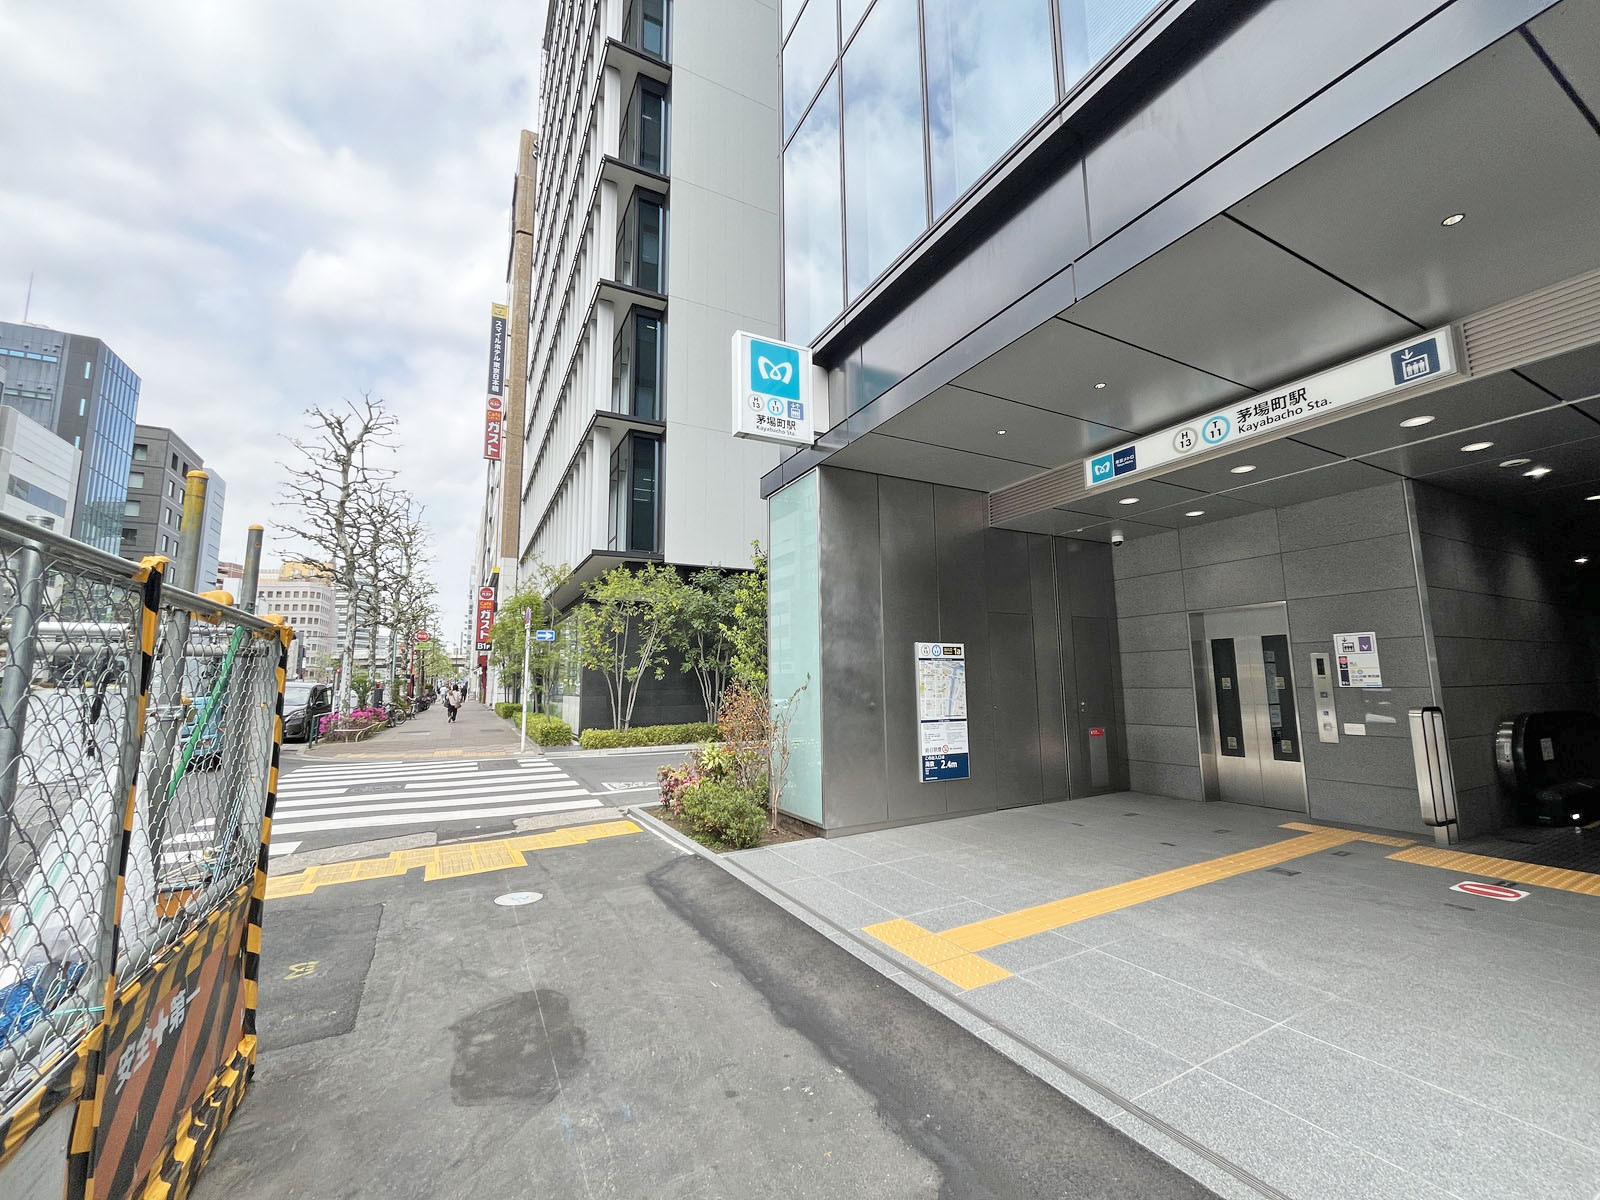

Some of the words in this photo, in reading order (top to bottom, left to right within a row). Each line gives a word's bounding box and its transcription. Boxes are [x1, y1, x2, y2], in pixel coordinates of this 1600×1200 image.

[1236, 387, 1308, 424] 茅場町駅
[1238, 406, 1303, 434] Kayabacho
[1307, 397, 1333, 411] Sta.
[756, 414, 797, 431] 茅場町駅
[1212, 421, 1219, 429] T
[756, 425, 786, 435] Kayabacho
[1181, 431, 1189, 439] H
[1210, 428, 1222, 439] 11
[488, 421, 500, 456] ガスト
[1180, 438, 1192, 449] 13
[480, 609, 491, 640] ガスト
[940, 760, 958, 769] 2.4m
